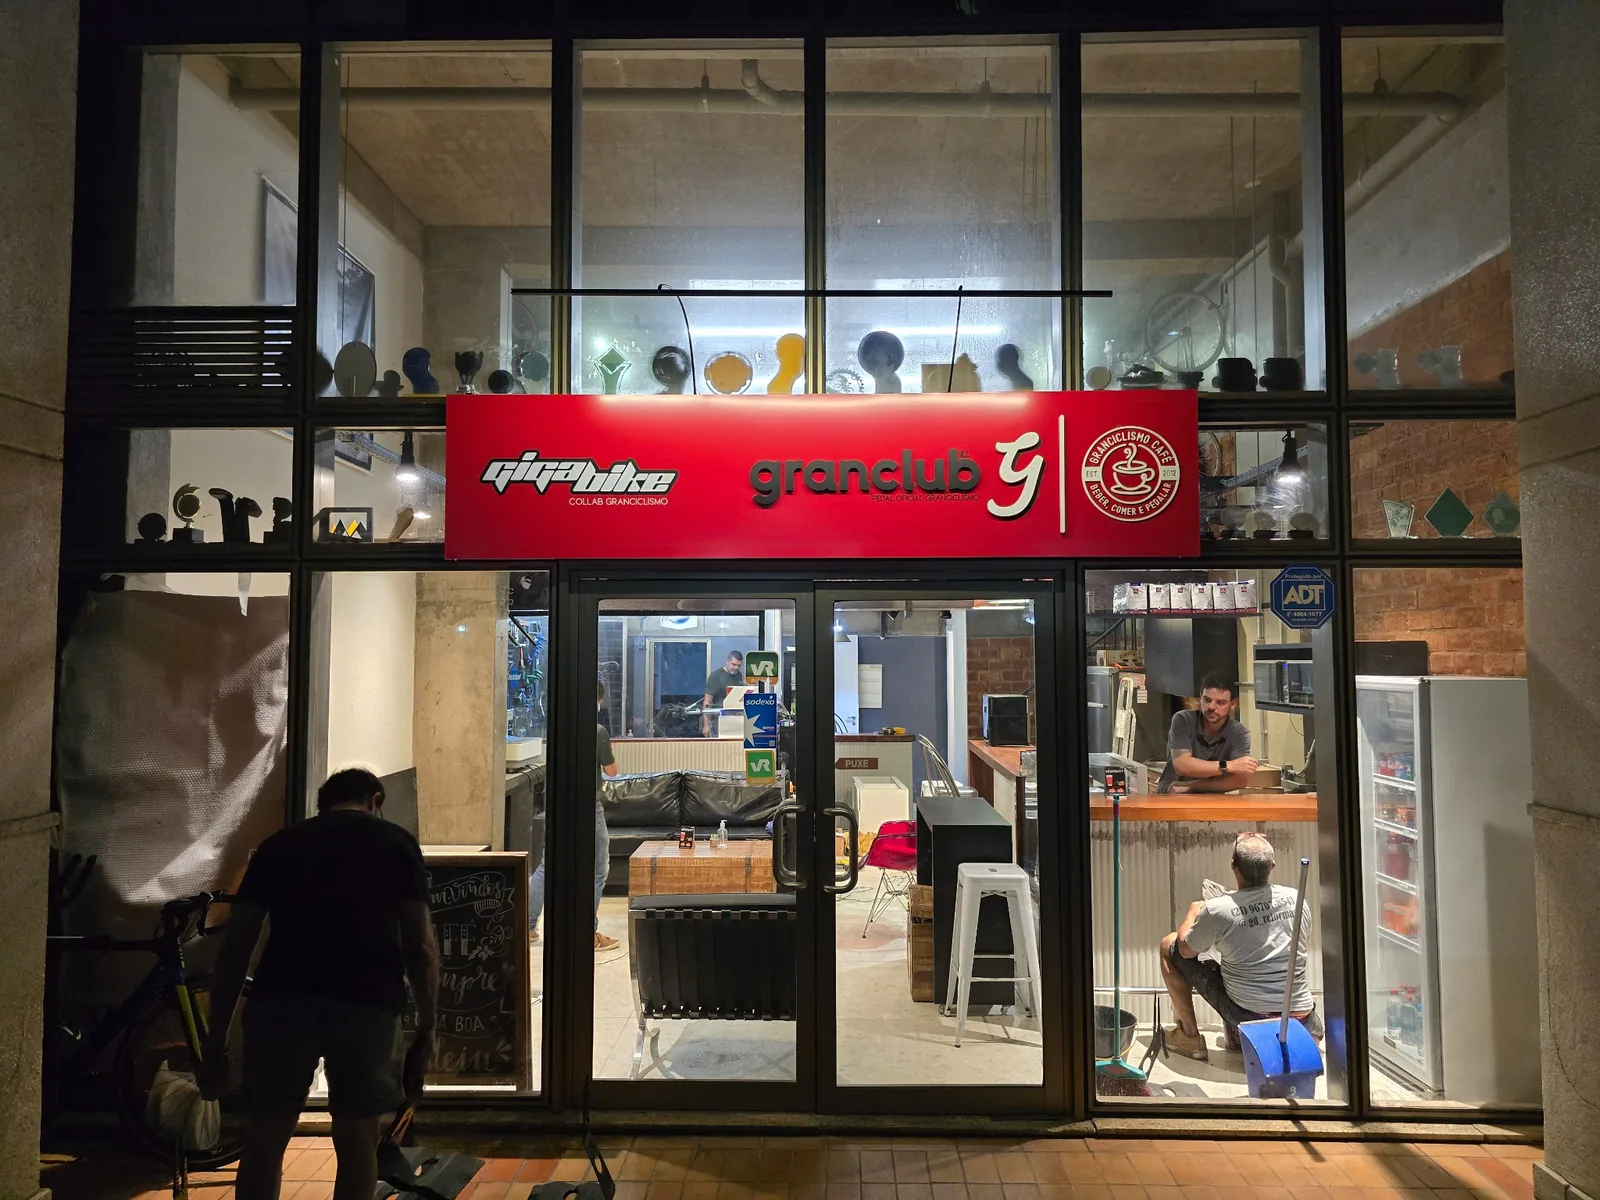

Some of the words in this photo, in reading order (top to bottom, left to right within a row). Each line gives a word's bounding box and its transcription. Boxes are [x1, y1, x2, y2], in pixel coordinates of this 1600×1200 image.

[1089, 431, 1151, 464] GRANCICLISMO
[1151, 440, 1174, 464] CAFÉ
[481, 451, 677, 494] gigabike
[750, 448, 981, 508] granclub
[1086, 470, 1099, 478] EST.
[1162, 469, 1177, 477] 2012
[568, 497, 604, 506] COLLAB
[605, 497, 669, 506] GRANCICLISMO
[896, 494, 922, 502] OFICIAL
[925, 493, 980, 502] GRANCICLISMO
[1089, 483, 1110, 509] BEBER,
[1110, 504, 1137, 516] COMER
[1138, 506, 1145, 515] E
[1145, 482, 1172, 512] PEDALAR
[1283, 584, 1325, 605] ADT
[745, 698, 775, 706] sodexo
[845, 759, 869, 768] PUXE
[455, 1015, 485, 1032] BOA
